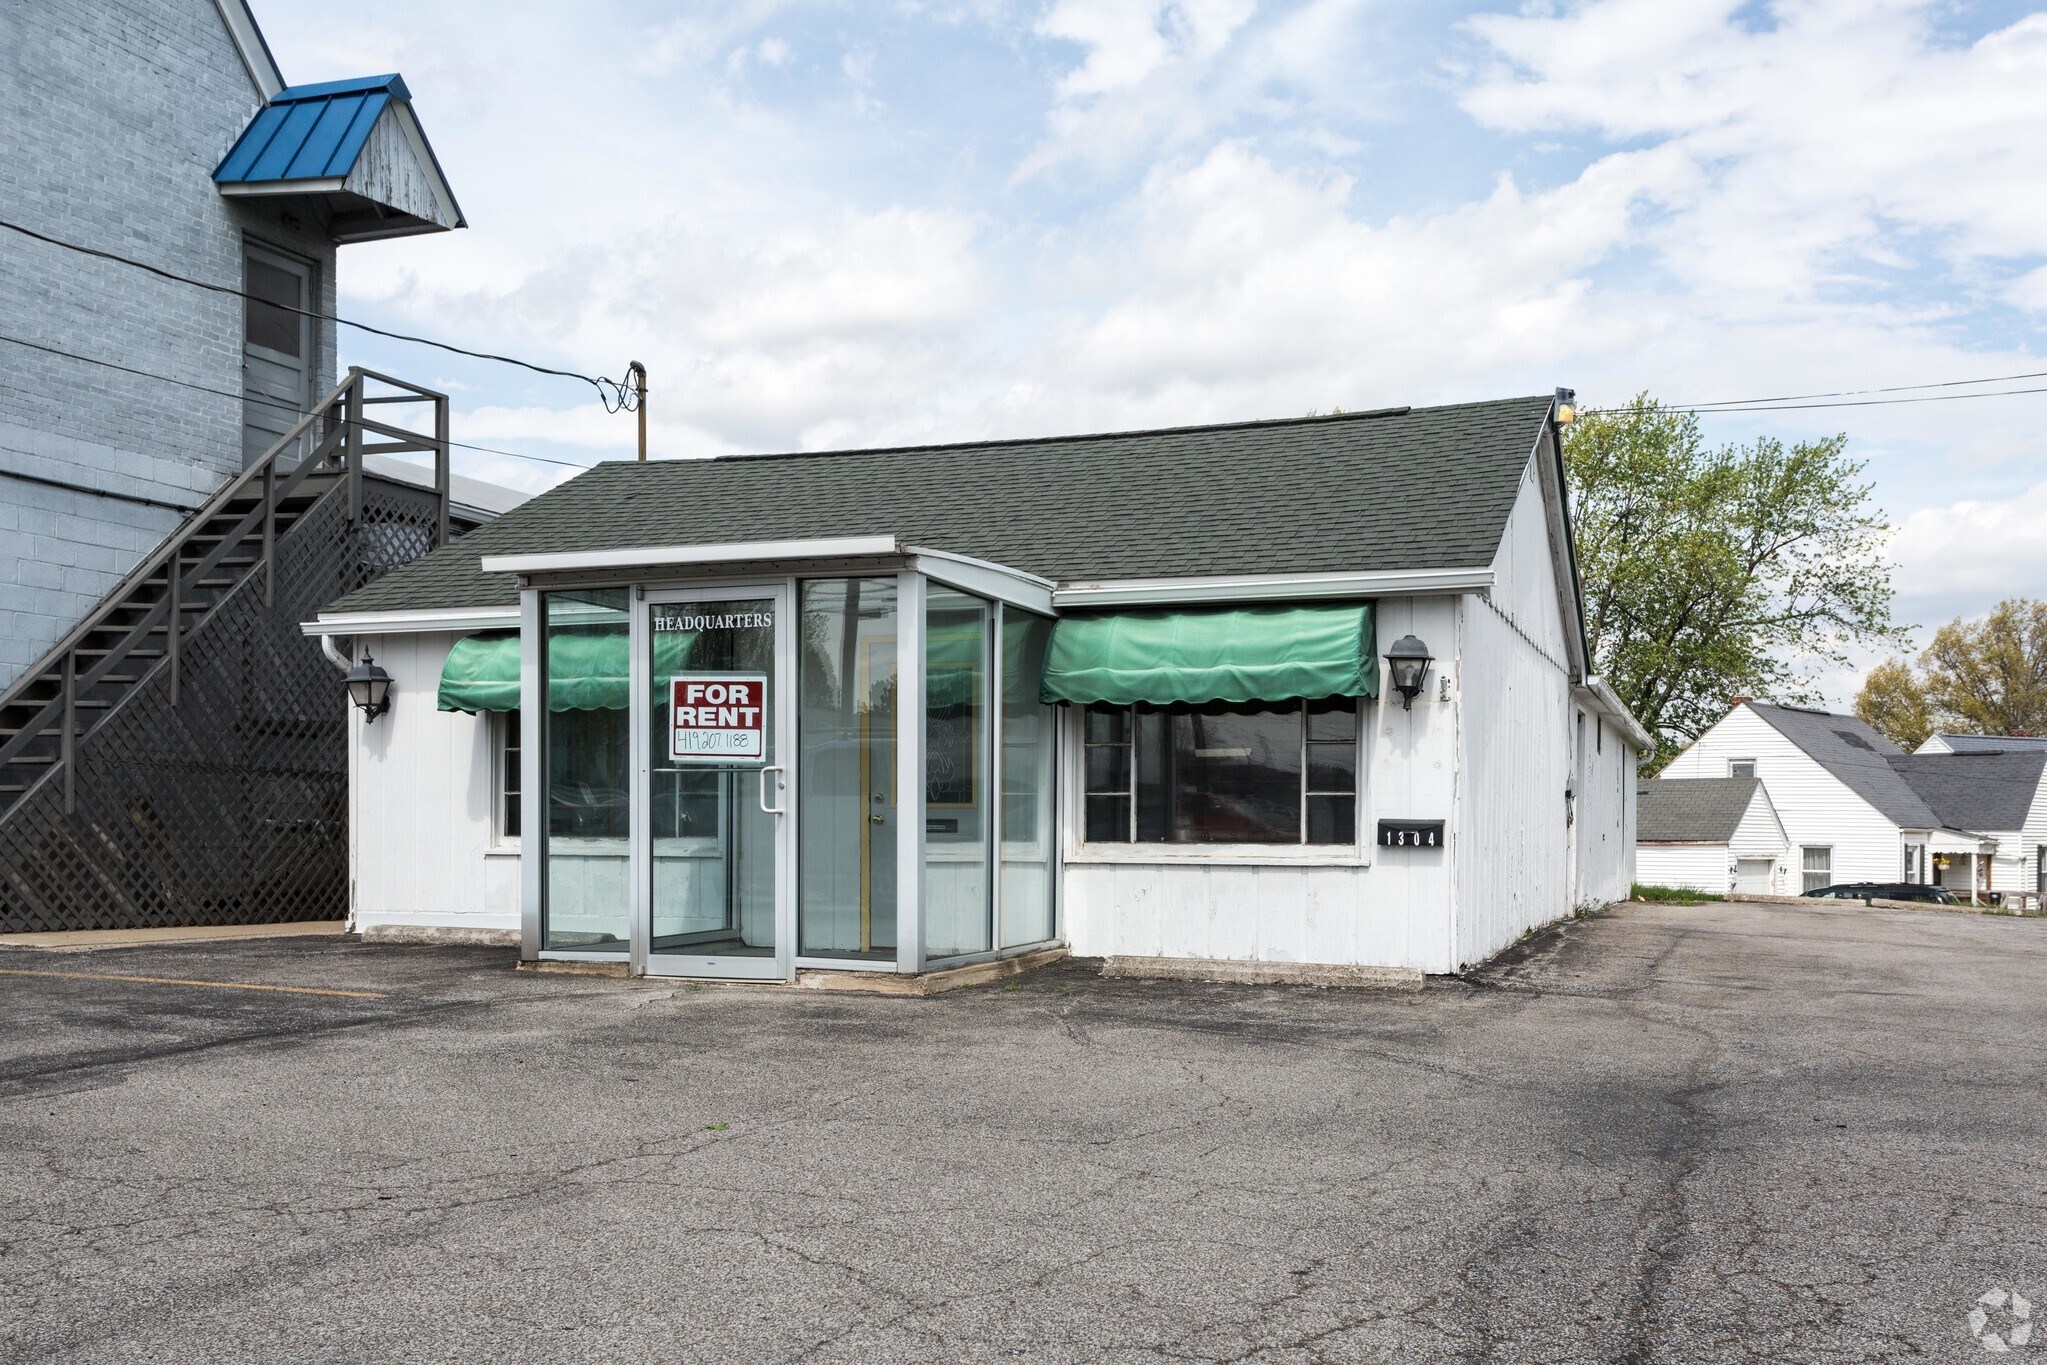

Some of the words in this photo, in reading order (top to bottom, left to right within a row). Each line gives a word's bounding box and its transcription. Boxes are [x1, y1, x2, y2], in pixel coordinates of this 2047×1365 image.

[654, 612, 772, 632] HEADQUARTERS
[687, 684, 749, 705] FOR
[676, 706, 760, 727] RENT
[1387, 831, 1435, 847] 1304
